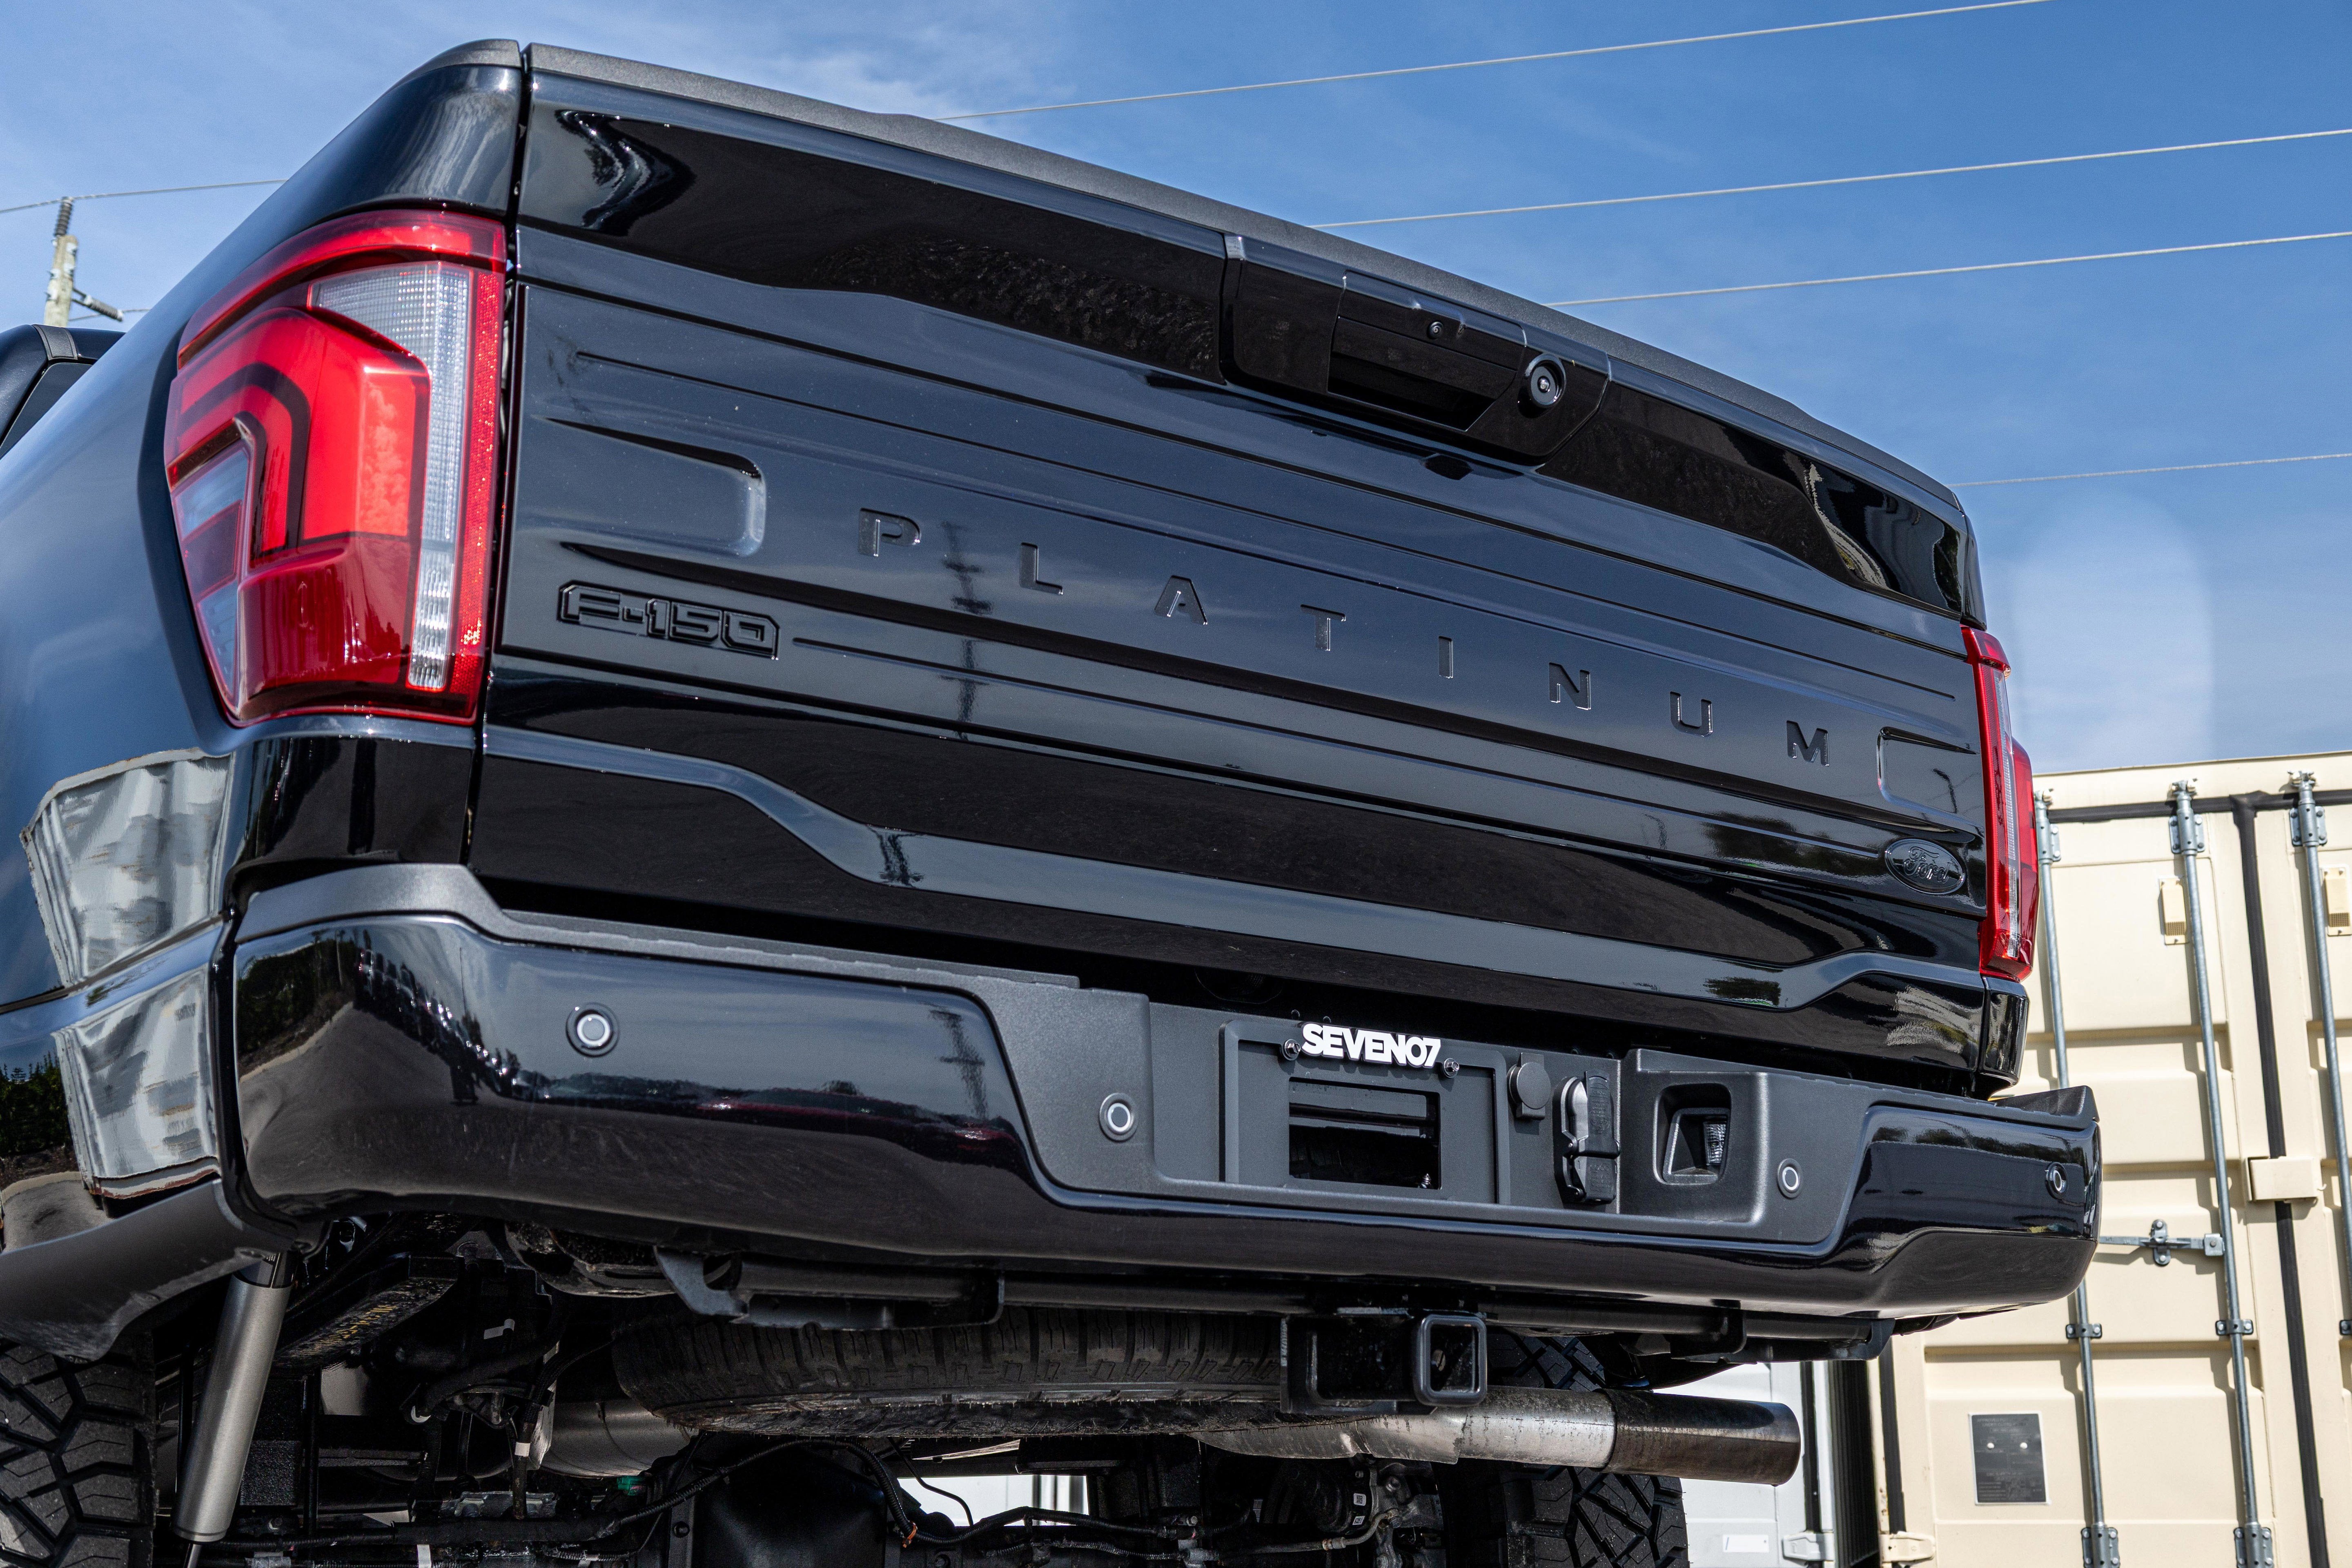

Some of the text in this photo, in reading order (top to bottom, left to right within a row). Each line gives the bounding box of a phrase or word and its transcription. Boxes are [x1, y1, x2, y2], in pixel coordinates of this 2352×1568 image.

[557, 579, 779, 660] F-150
[858, 507, 1830, 766] PLATINUM
[1903, 846, 1951, 884] Ford
